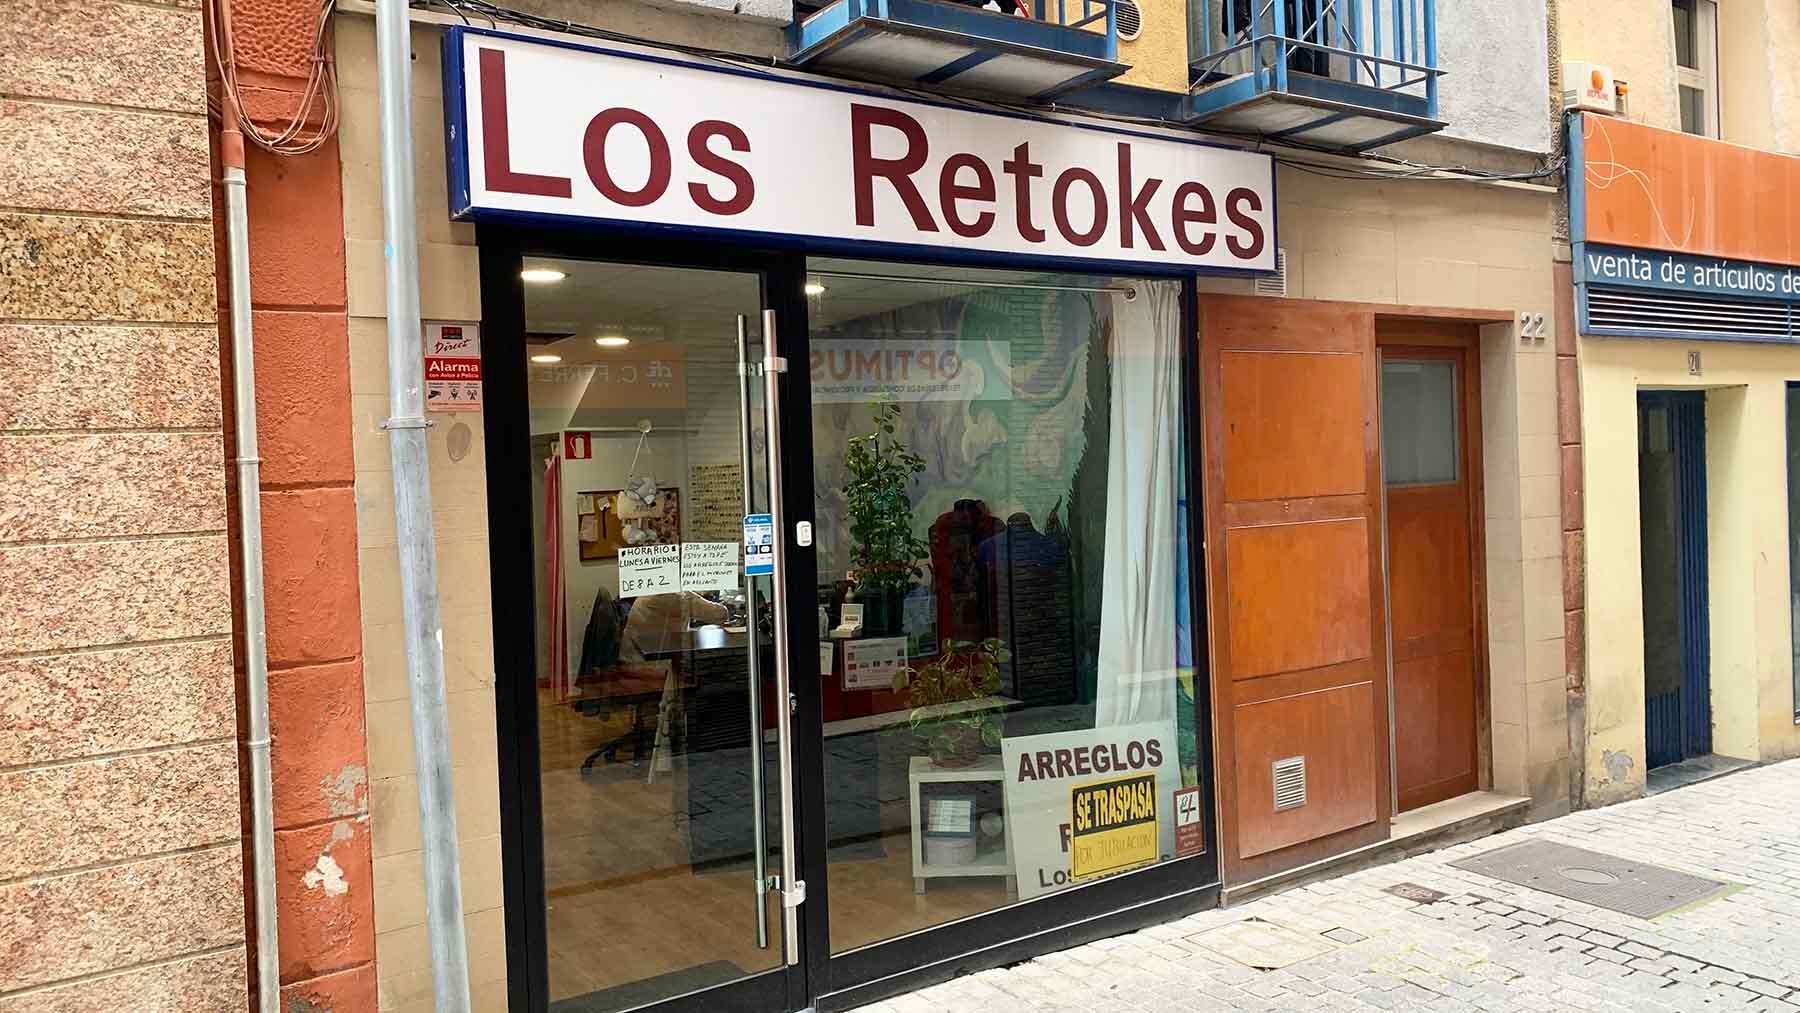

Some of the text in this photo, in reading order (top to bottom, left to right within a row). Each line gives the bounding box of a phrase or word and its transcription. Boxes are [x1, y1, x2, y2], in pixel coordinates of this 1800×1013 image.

[479, 46, 1265, 260] Los Retokes
[1588, 253, 1652, 281] venta
[1660, 256, 1686, 284] de
[1693, 260, 1776, 292] artículos
[1520, 311, 1546, 340] 22
[428, 360, 479, 372] Alarma
[619, 557, 644, 568] LUNES
[627, 545, 670, 556] HORARIO
[622, 579, 635, 592] DE
[1018, 739, 1163, 782] ARREGLOS
[1076, 791, 1092, 832] SE
[1093, 781, 1154, 828] TRASPASA
